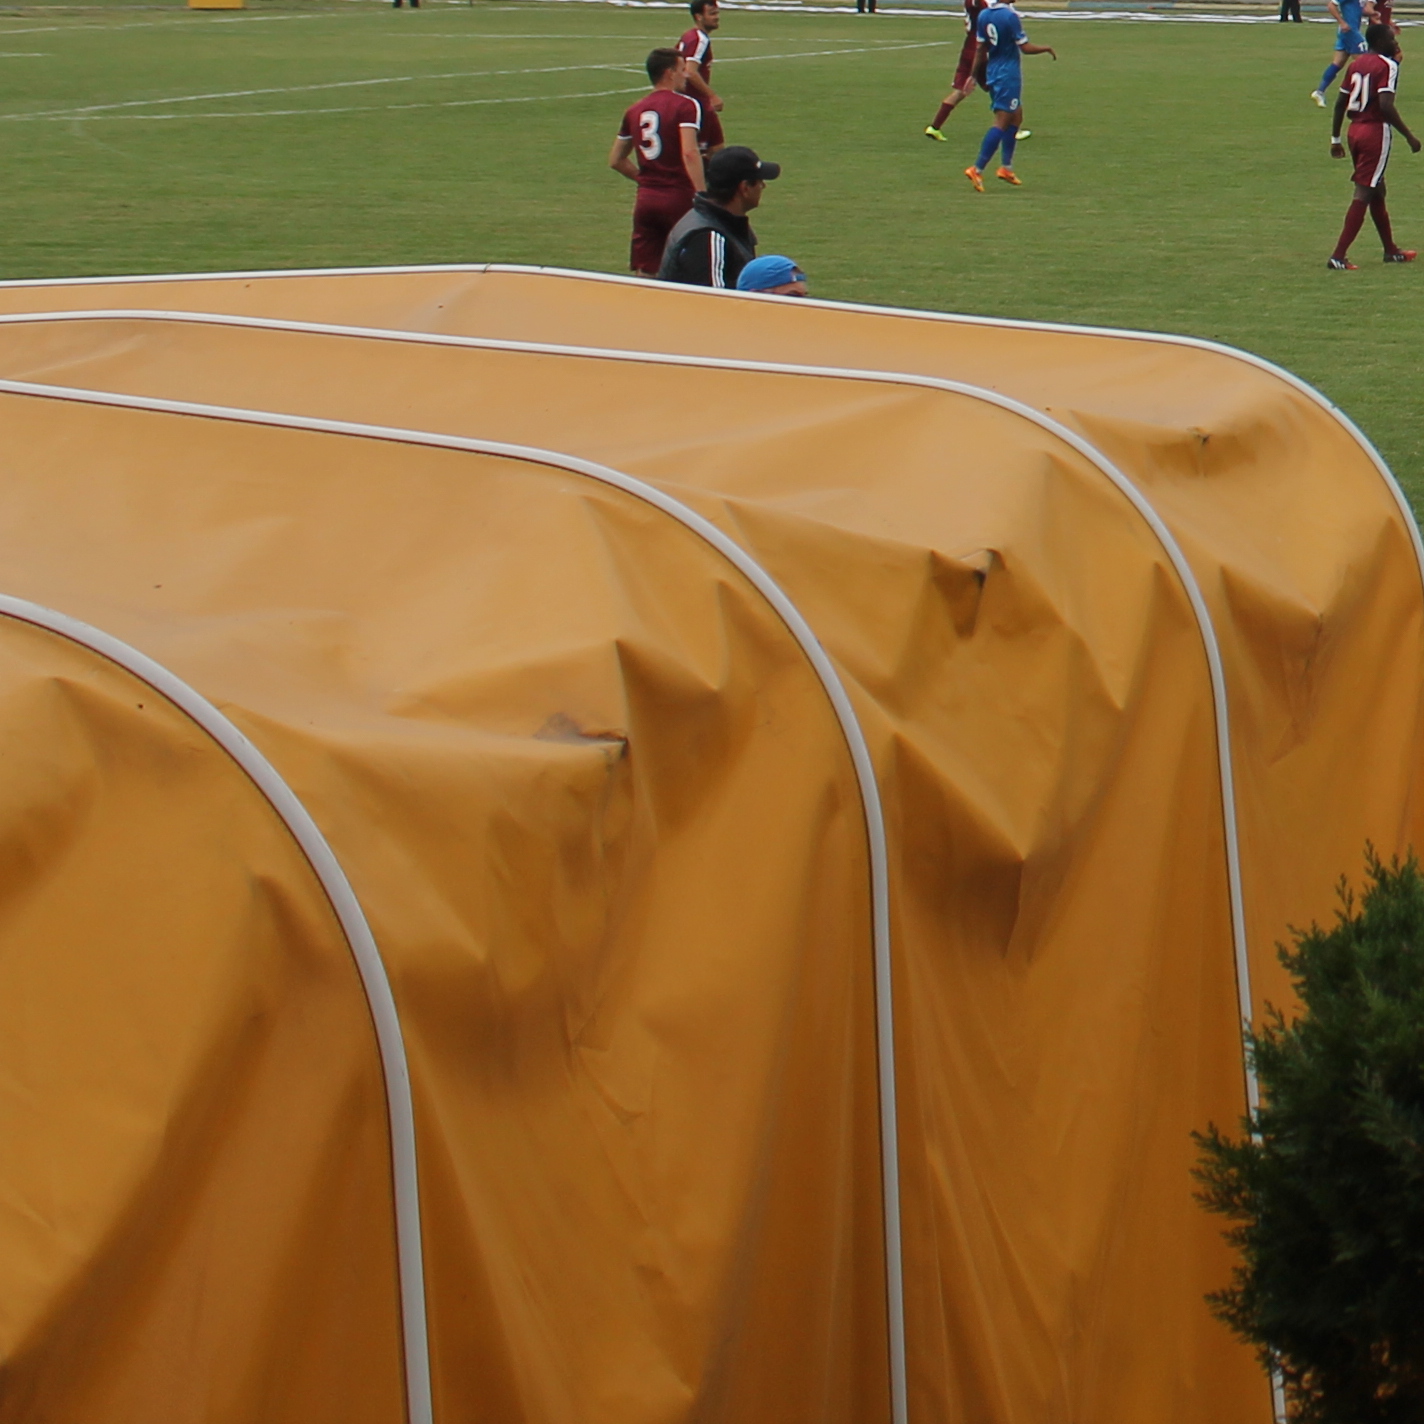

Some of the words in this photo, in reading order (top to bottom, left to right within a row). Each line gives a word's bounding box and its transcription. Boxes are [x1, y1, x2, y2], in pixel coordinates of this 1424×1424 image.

[987, 23, 999, 46] 9
[1347, 71, 1370, 113] 21
[639, 110, 663, 161] 3
